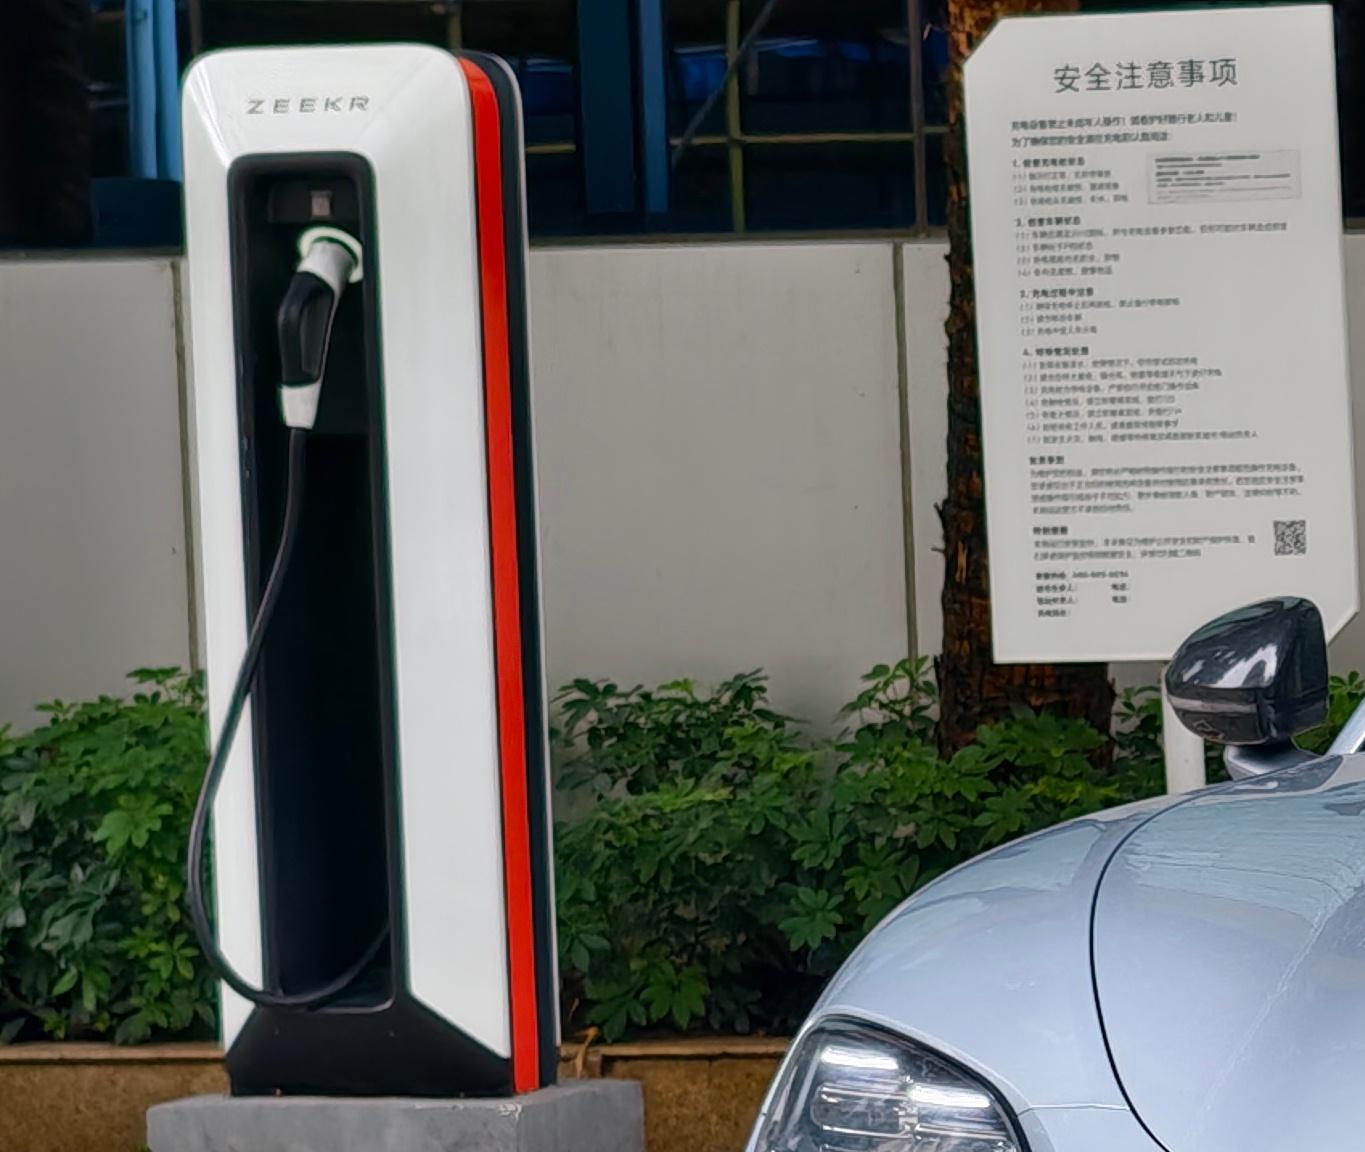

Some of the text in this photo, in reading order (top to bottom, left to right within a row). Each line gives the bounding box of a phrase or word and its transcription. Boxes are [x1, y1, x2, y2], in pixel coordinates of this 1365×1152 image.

[1053, 58, 1239, 93] 安全注意事项
[246, 96, 371, 114] ZEEKR
